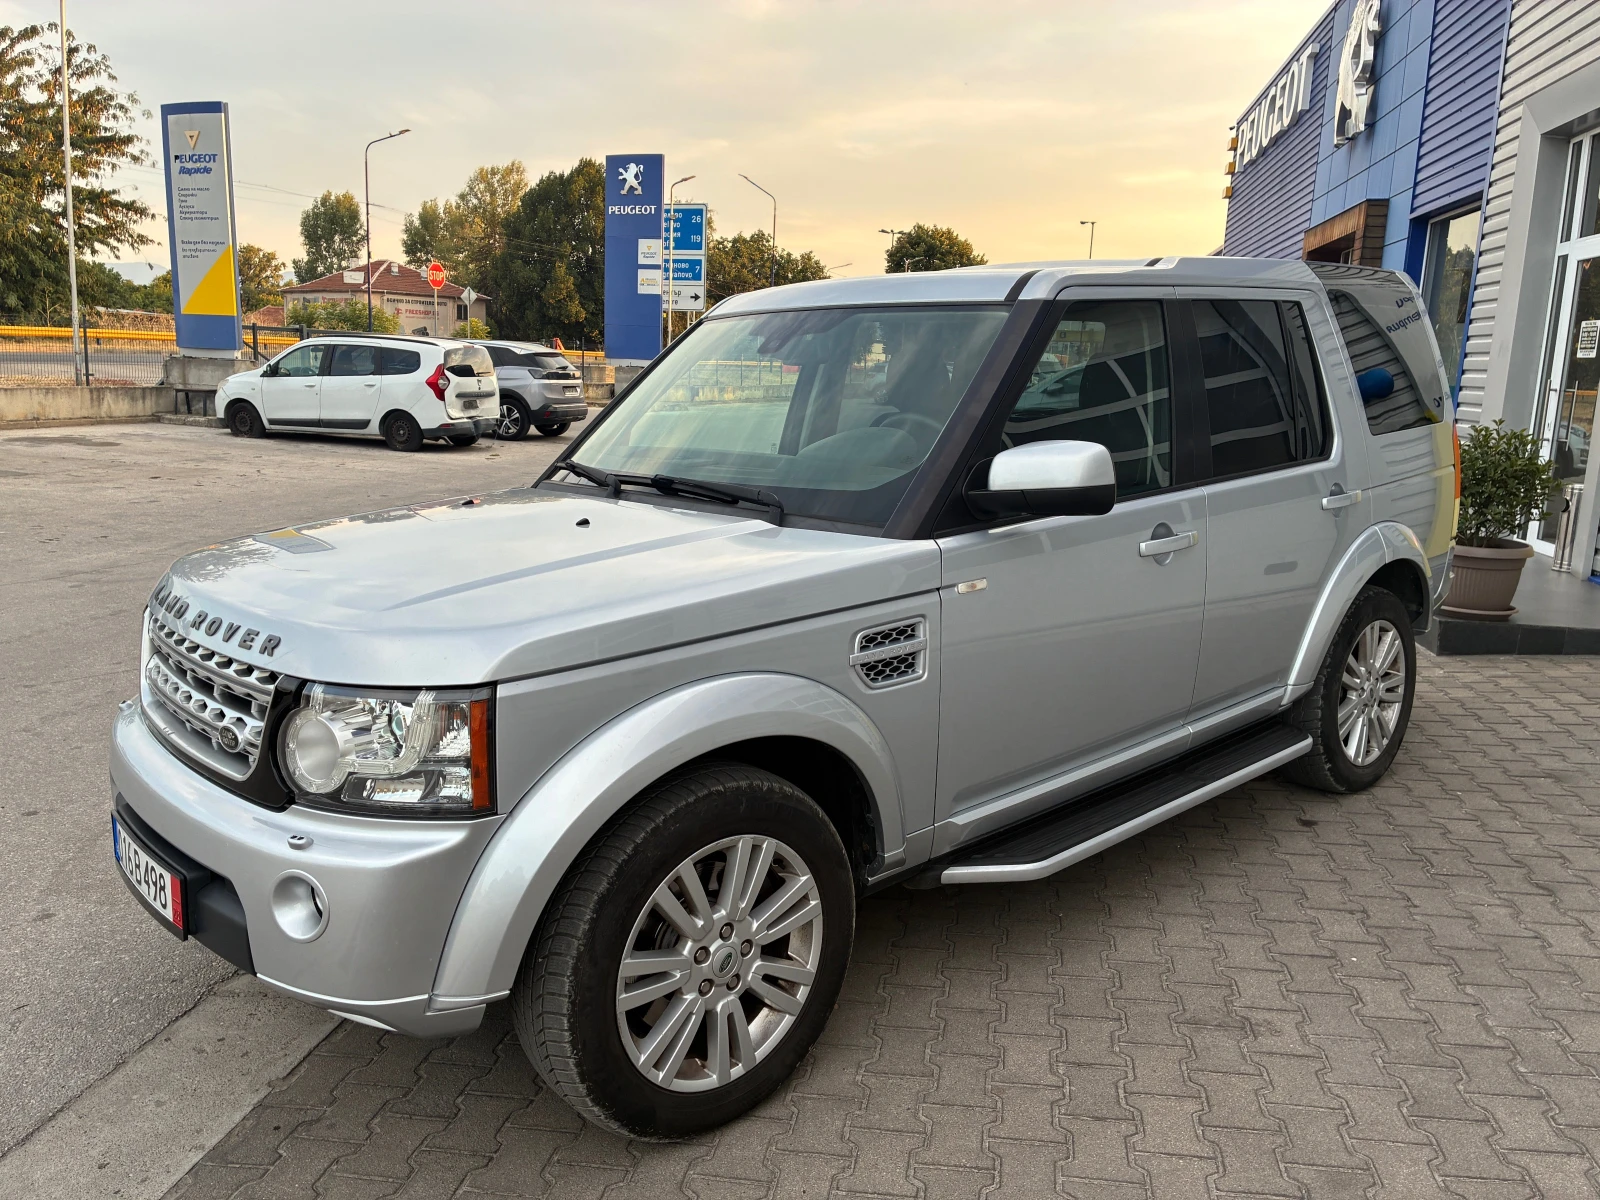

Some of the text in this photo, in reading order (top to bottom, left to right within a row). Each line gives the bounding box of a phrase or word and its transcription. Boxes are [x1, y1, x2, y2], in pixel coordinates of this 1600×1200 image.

[1235, 43, 1319, 173] PEUGEOT
[174, 153, 218, 164] PEUGEOT
[178, 164, 213, 176] Rapide
[608, 205, 657, 215] PEUGEOT
[690, 235, 701, 243] 119
[429, 270, 444, 281] STOP
[695, 266, 700, 274] 7
[153, 584, 282, 658] LAND ROVER
[858, 642, 923, 663] LAND ROVER
